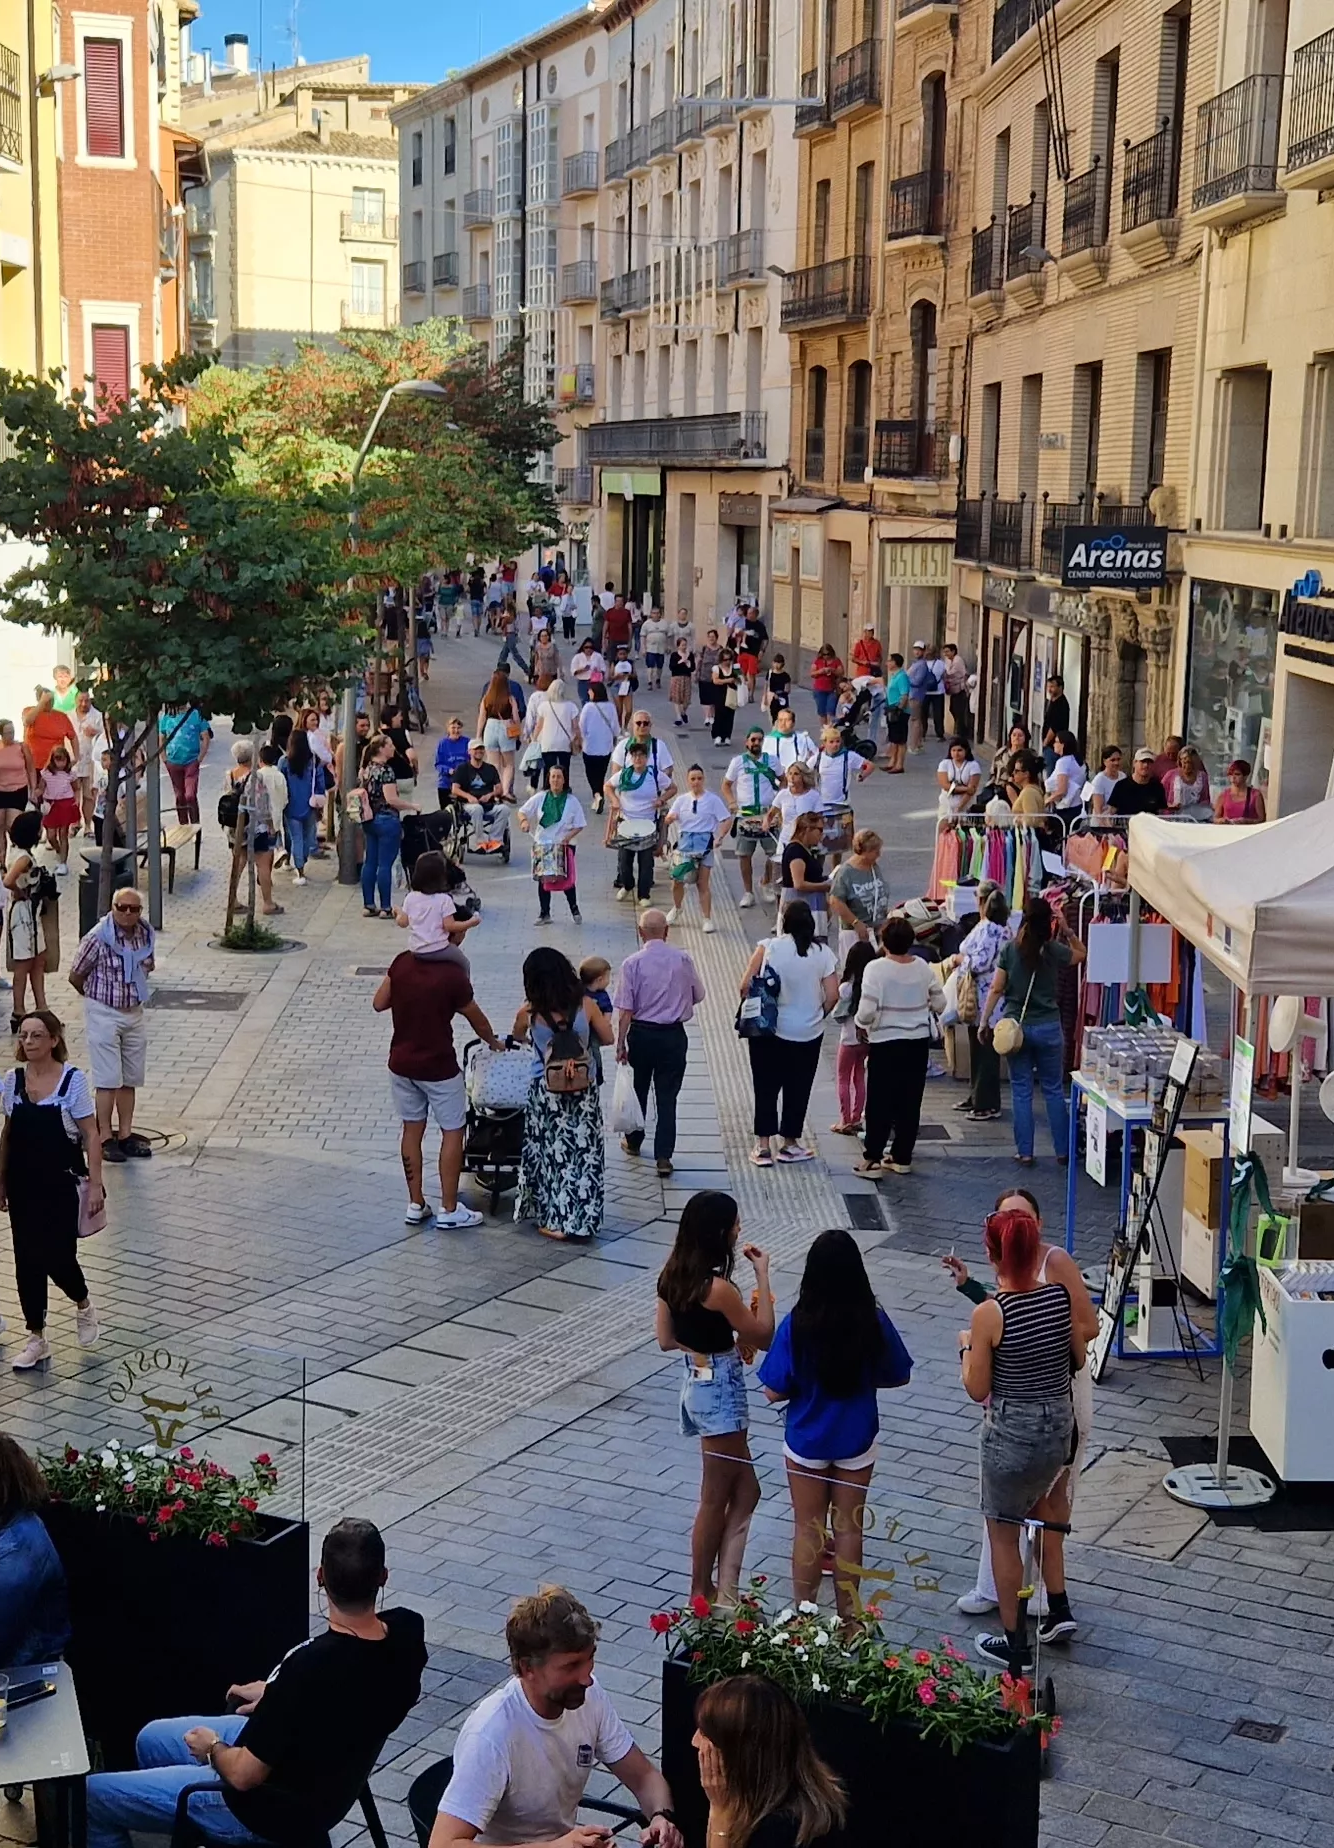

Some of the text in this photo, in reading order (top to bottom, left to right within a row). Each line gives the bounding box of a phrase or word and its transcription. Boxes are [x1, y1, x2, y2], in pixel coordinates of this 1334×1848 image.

[1068, 543, 1164, 568] Arenas
[1068, 571, 1095, 579] CENTRO
[1096, 569, 1122, 579] ÓPTICO
[1129, 571, 1162, 580] AUDITIVO
